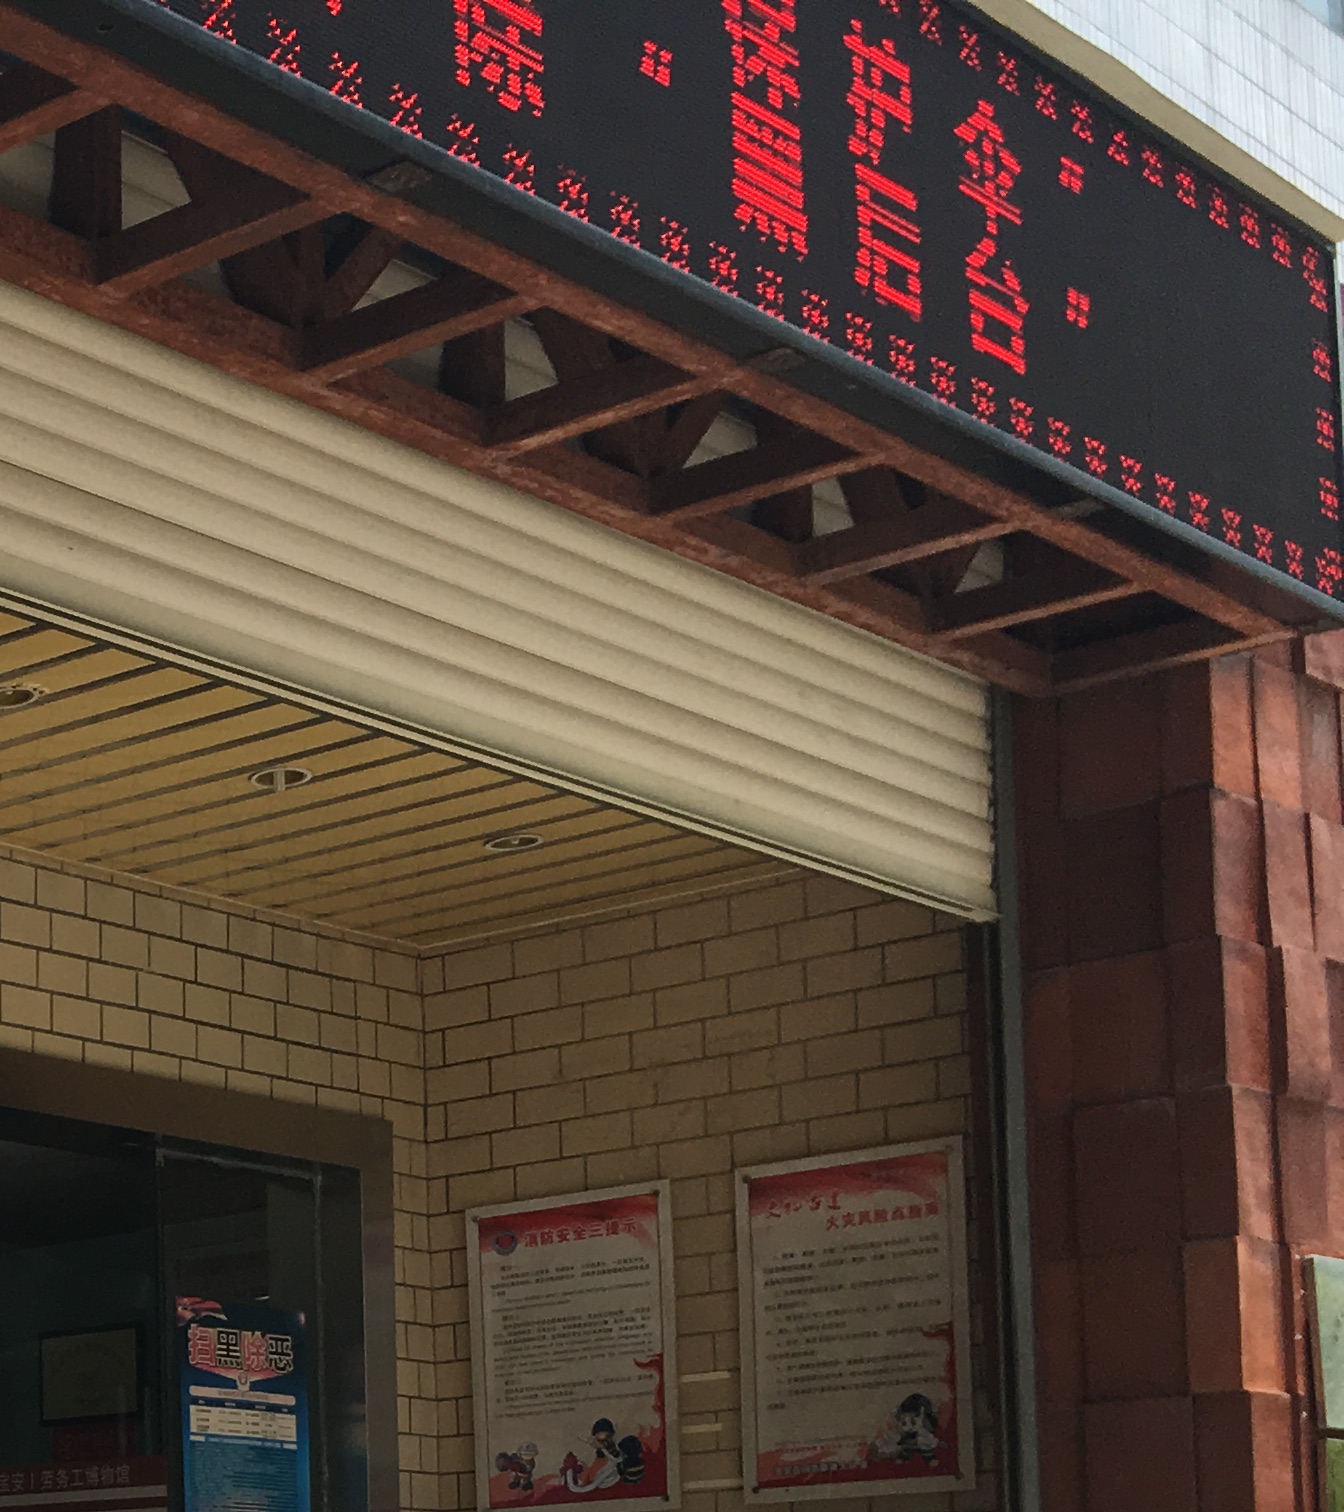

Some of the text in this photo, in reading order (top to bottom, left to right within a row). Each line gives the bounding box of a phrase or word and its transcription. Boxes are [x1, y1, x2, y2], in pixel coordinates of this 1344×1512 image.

[523, 1217, 637, 1248] 消防安全三提示
[187, 1324, 295, 1373] 扫黑除恶
